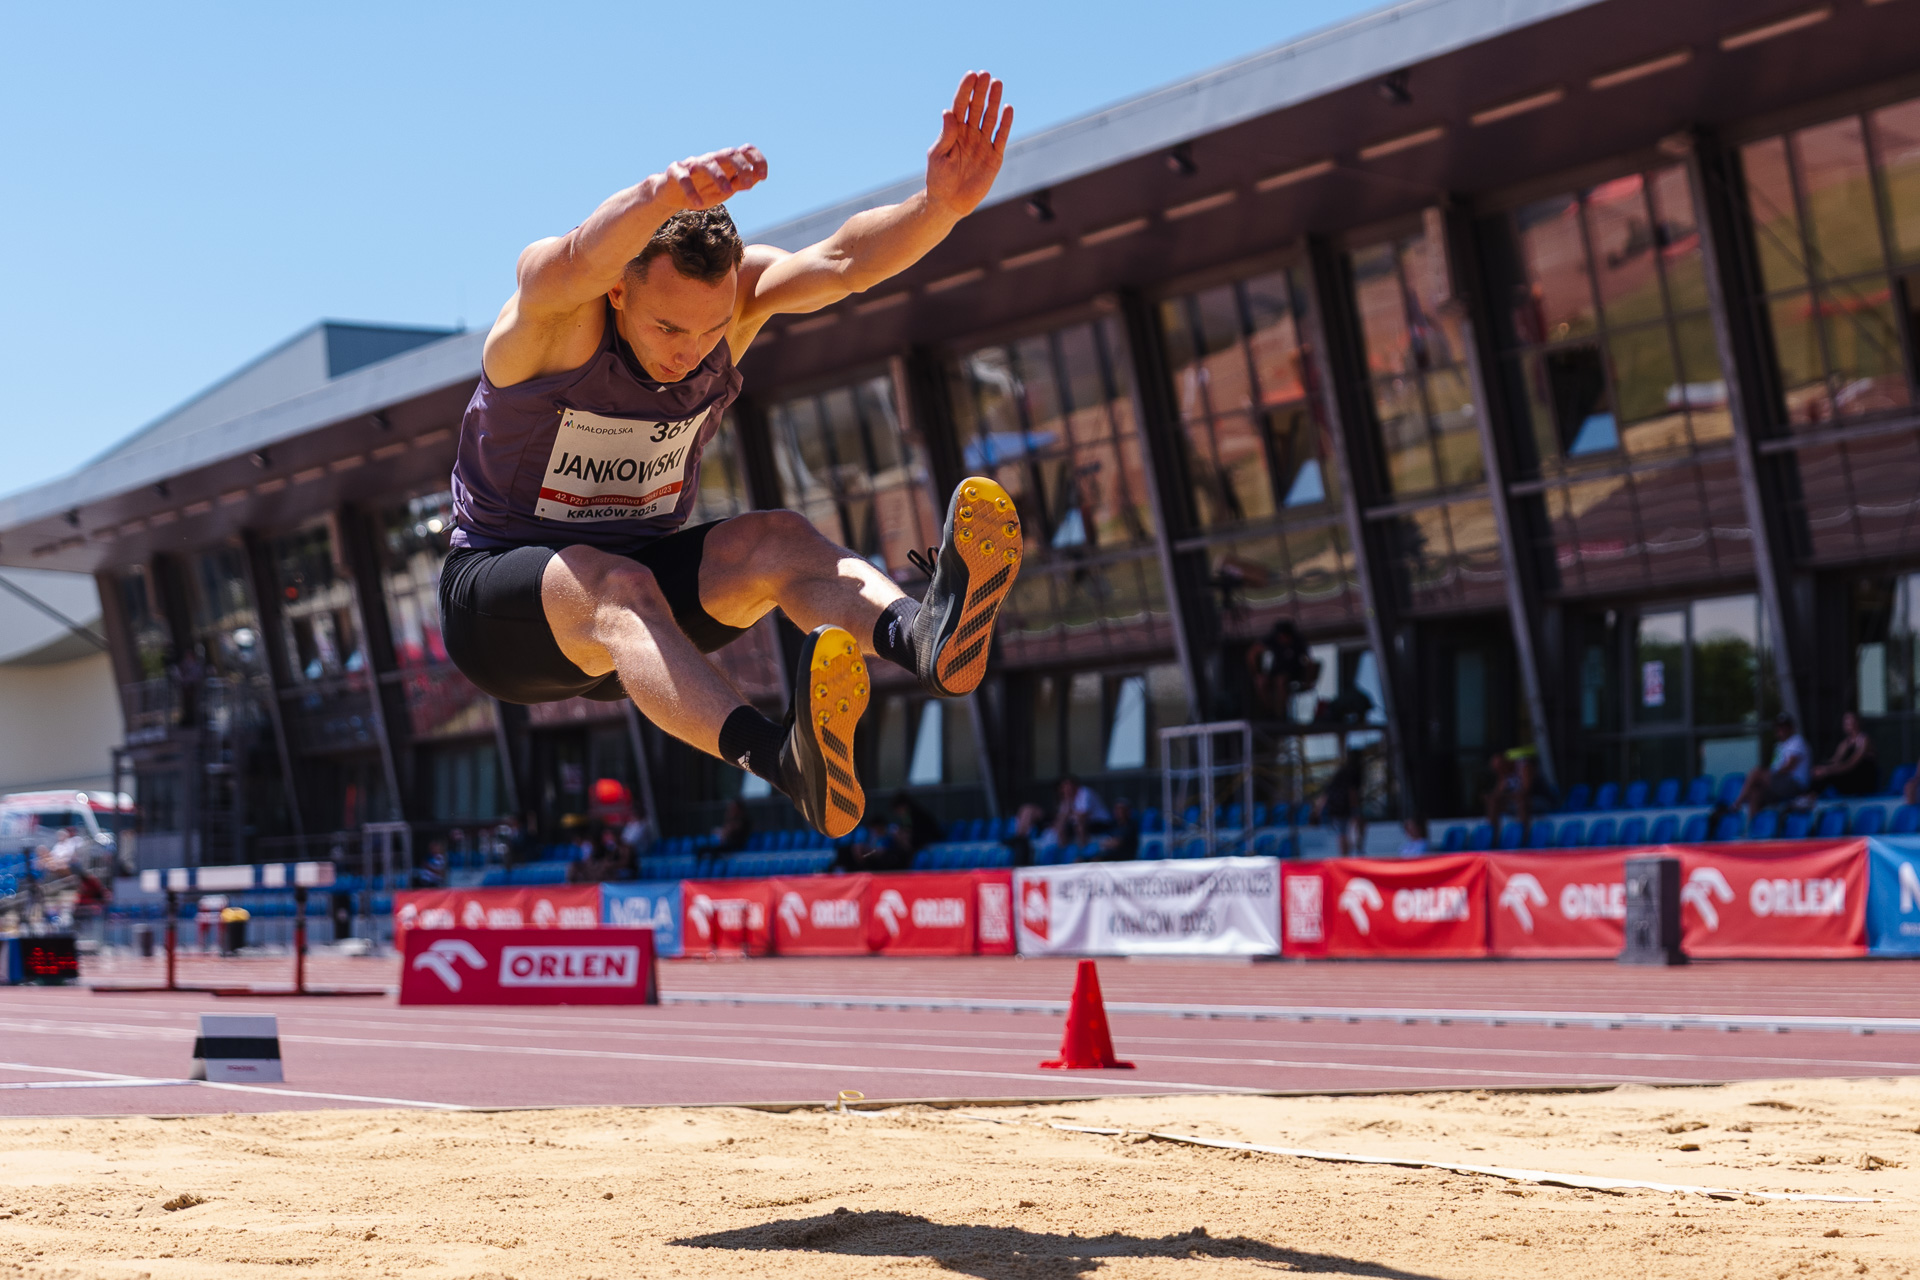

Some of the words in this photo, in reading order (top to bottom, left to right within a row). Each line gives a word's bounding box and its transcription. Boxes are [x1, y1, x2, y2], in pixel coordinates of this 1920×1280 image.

[576, 423, 634, 435] MAŁOPOLSKA
[553, 446, 686, 484] JANKOWSKI
[591, 496, 640, 505] Mistrzostwa
[659, 485, 672, 496] U23
[567, 506, 628, 519] KRAKÓW
[630, 502, 658, 518] 2025
[1559, 883, 1627, 919] ORLE
[1749, 878, 1846, 917] ORLEN
[511, 954, 626, 978] ORLEN
